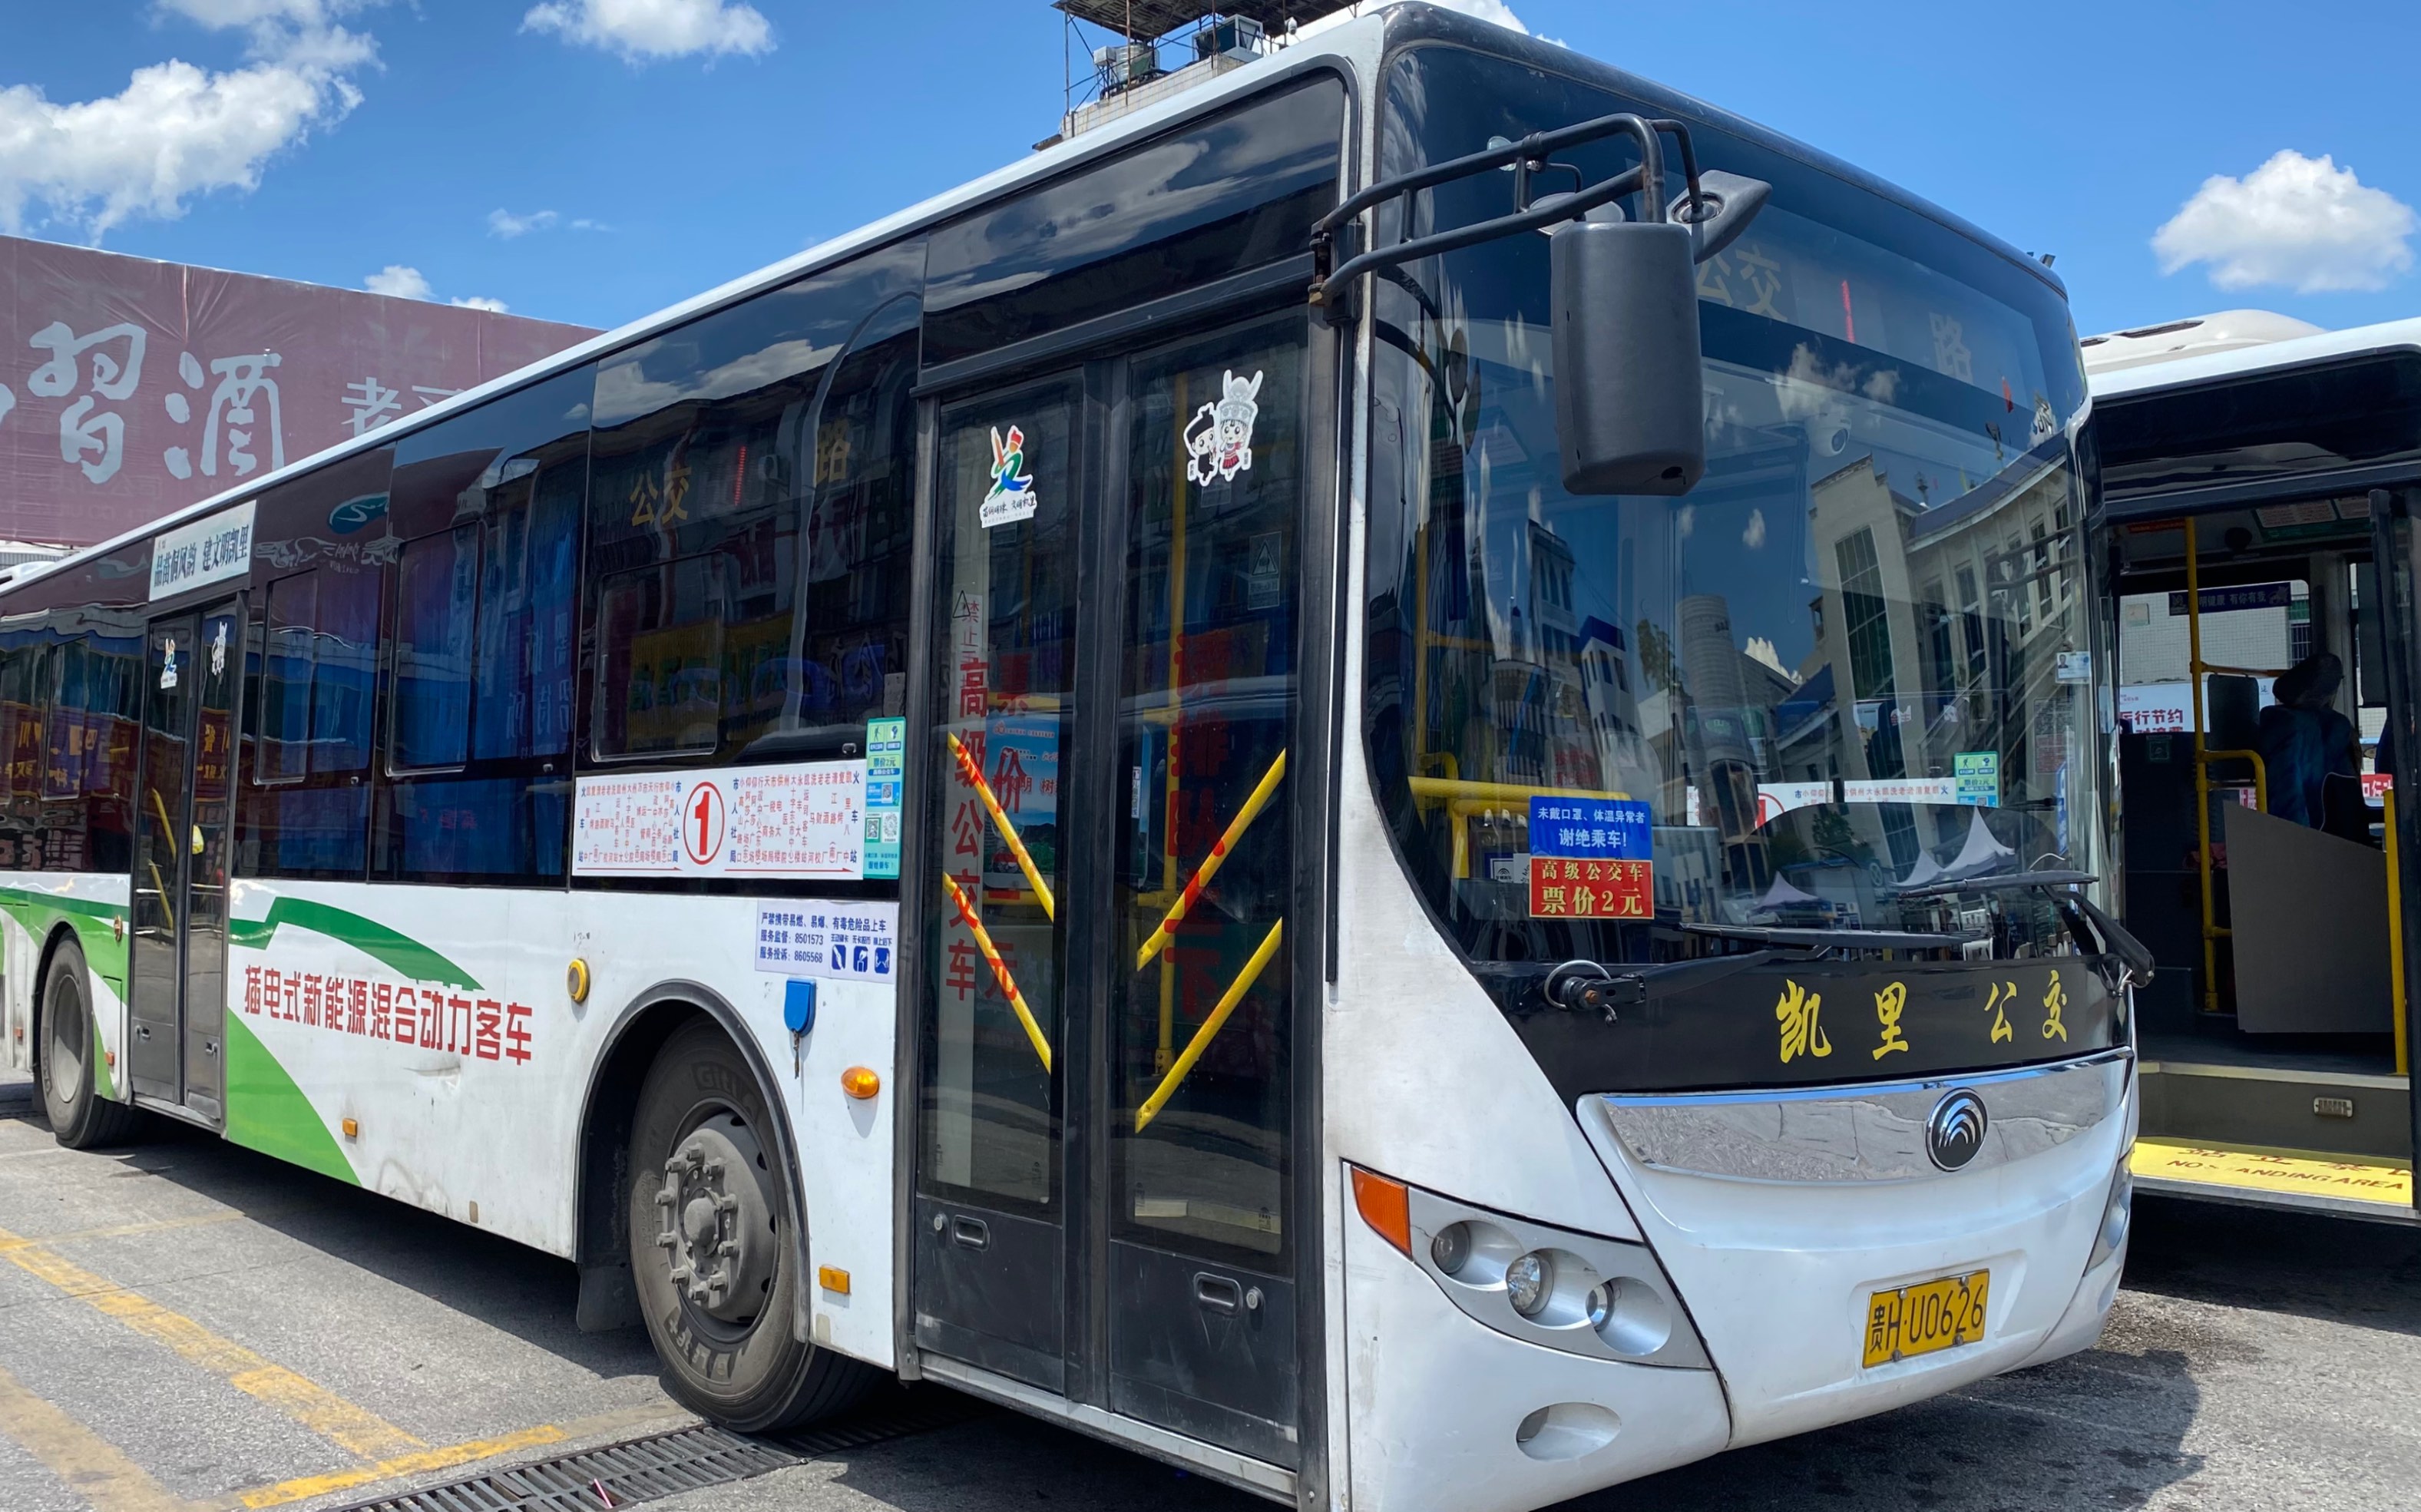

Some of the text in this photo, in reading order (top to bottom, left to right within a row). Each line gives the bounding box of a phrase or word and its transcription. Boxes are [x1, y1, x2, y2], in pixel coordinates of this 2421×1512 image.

[1696, 244, 1788, 323] 公交
[1930, 311, 1975, 384] 路
[0, 321, 285, 485] 習酒
[630, 468, 690, 527] 公交
[202, 524, 249, 572] 建文明凯里
[2198, 594, 2225, 607] 明健康
[694, 791, 710, 855] 1
[1538, 807, 1645, 824] 未戴口罩、体温异常者
[1559, 828, 1627, 849] 谢绝乘车！
[1542, 861, 1644, 882] 高级公交车
[1541, 885, 1644, 915] 票价2元
[245, 964, 533, 1066] 插电式新能源混合动力客车
[2166, 1160, 2202, 1169] NO
[2331, 1176, 2404, 1190] AREA
